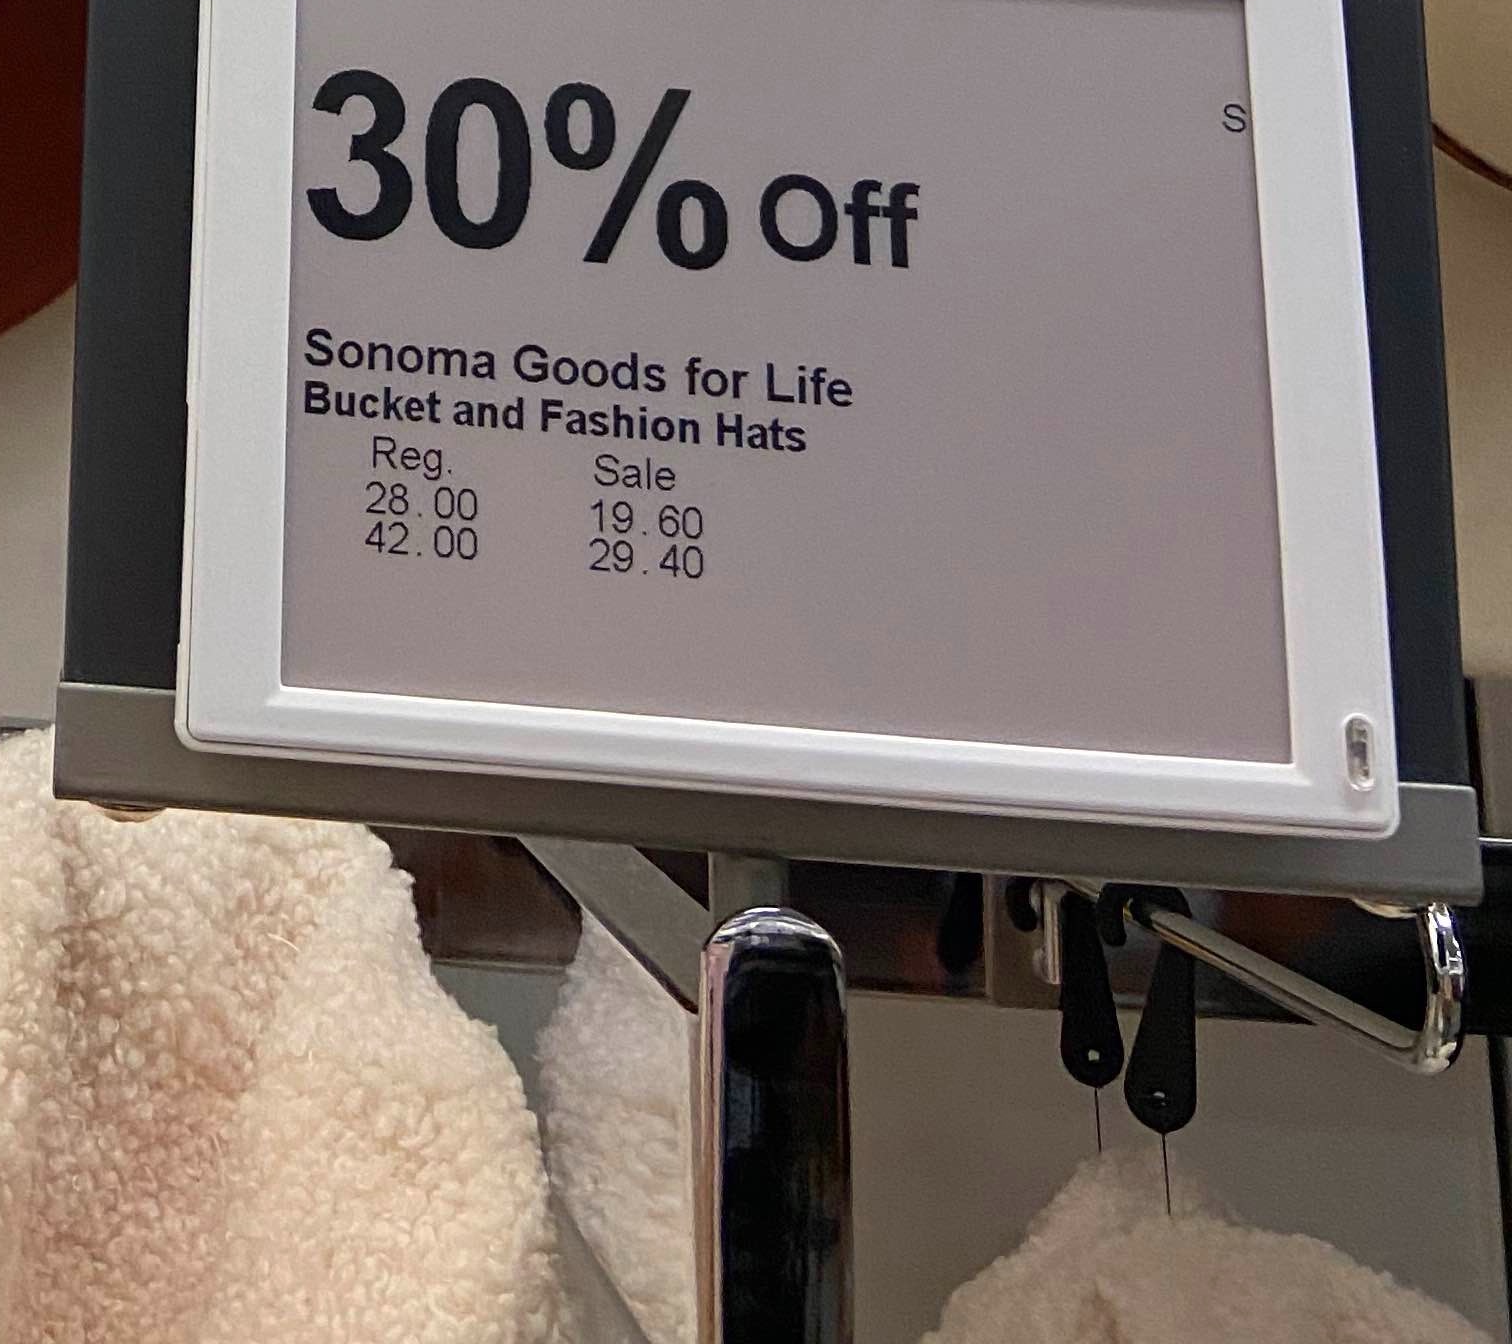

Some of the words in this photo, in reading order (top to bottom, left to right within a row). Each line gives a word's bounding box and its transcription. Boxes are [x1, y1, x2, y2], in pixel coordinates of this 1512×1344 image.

[306, 68, 729, 271] 30%
[759, 173, 920, 269] Off
[304, 327, 496, 381] Sonoma
[513, 344, 668, 393] Goods
[685, 357, 750, 400] for
[767, 363, 854, 408] Life
[304, 379, 441, 425] Bucket
[453, 396, 524, 432] and
[540, 397, 701, 445] Fashion
[716, 411, 807, 453] Hats
[372, 435, 453, 481] Reg.
[594, 453, 677, 492] Sale
[365, 481, 479, 522] 28.00
[590, 498, 705, 540] 19.60
[365, 520, 479, 561] 42.00
[589, 537, 705, 580] 29.40
